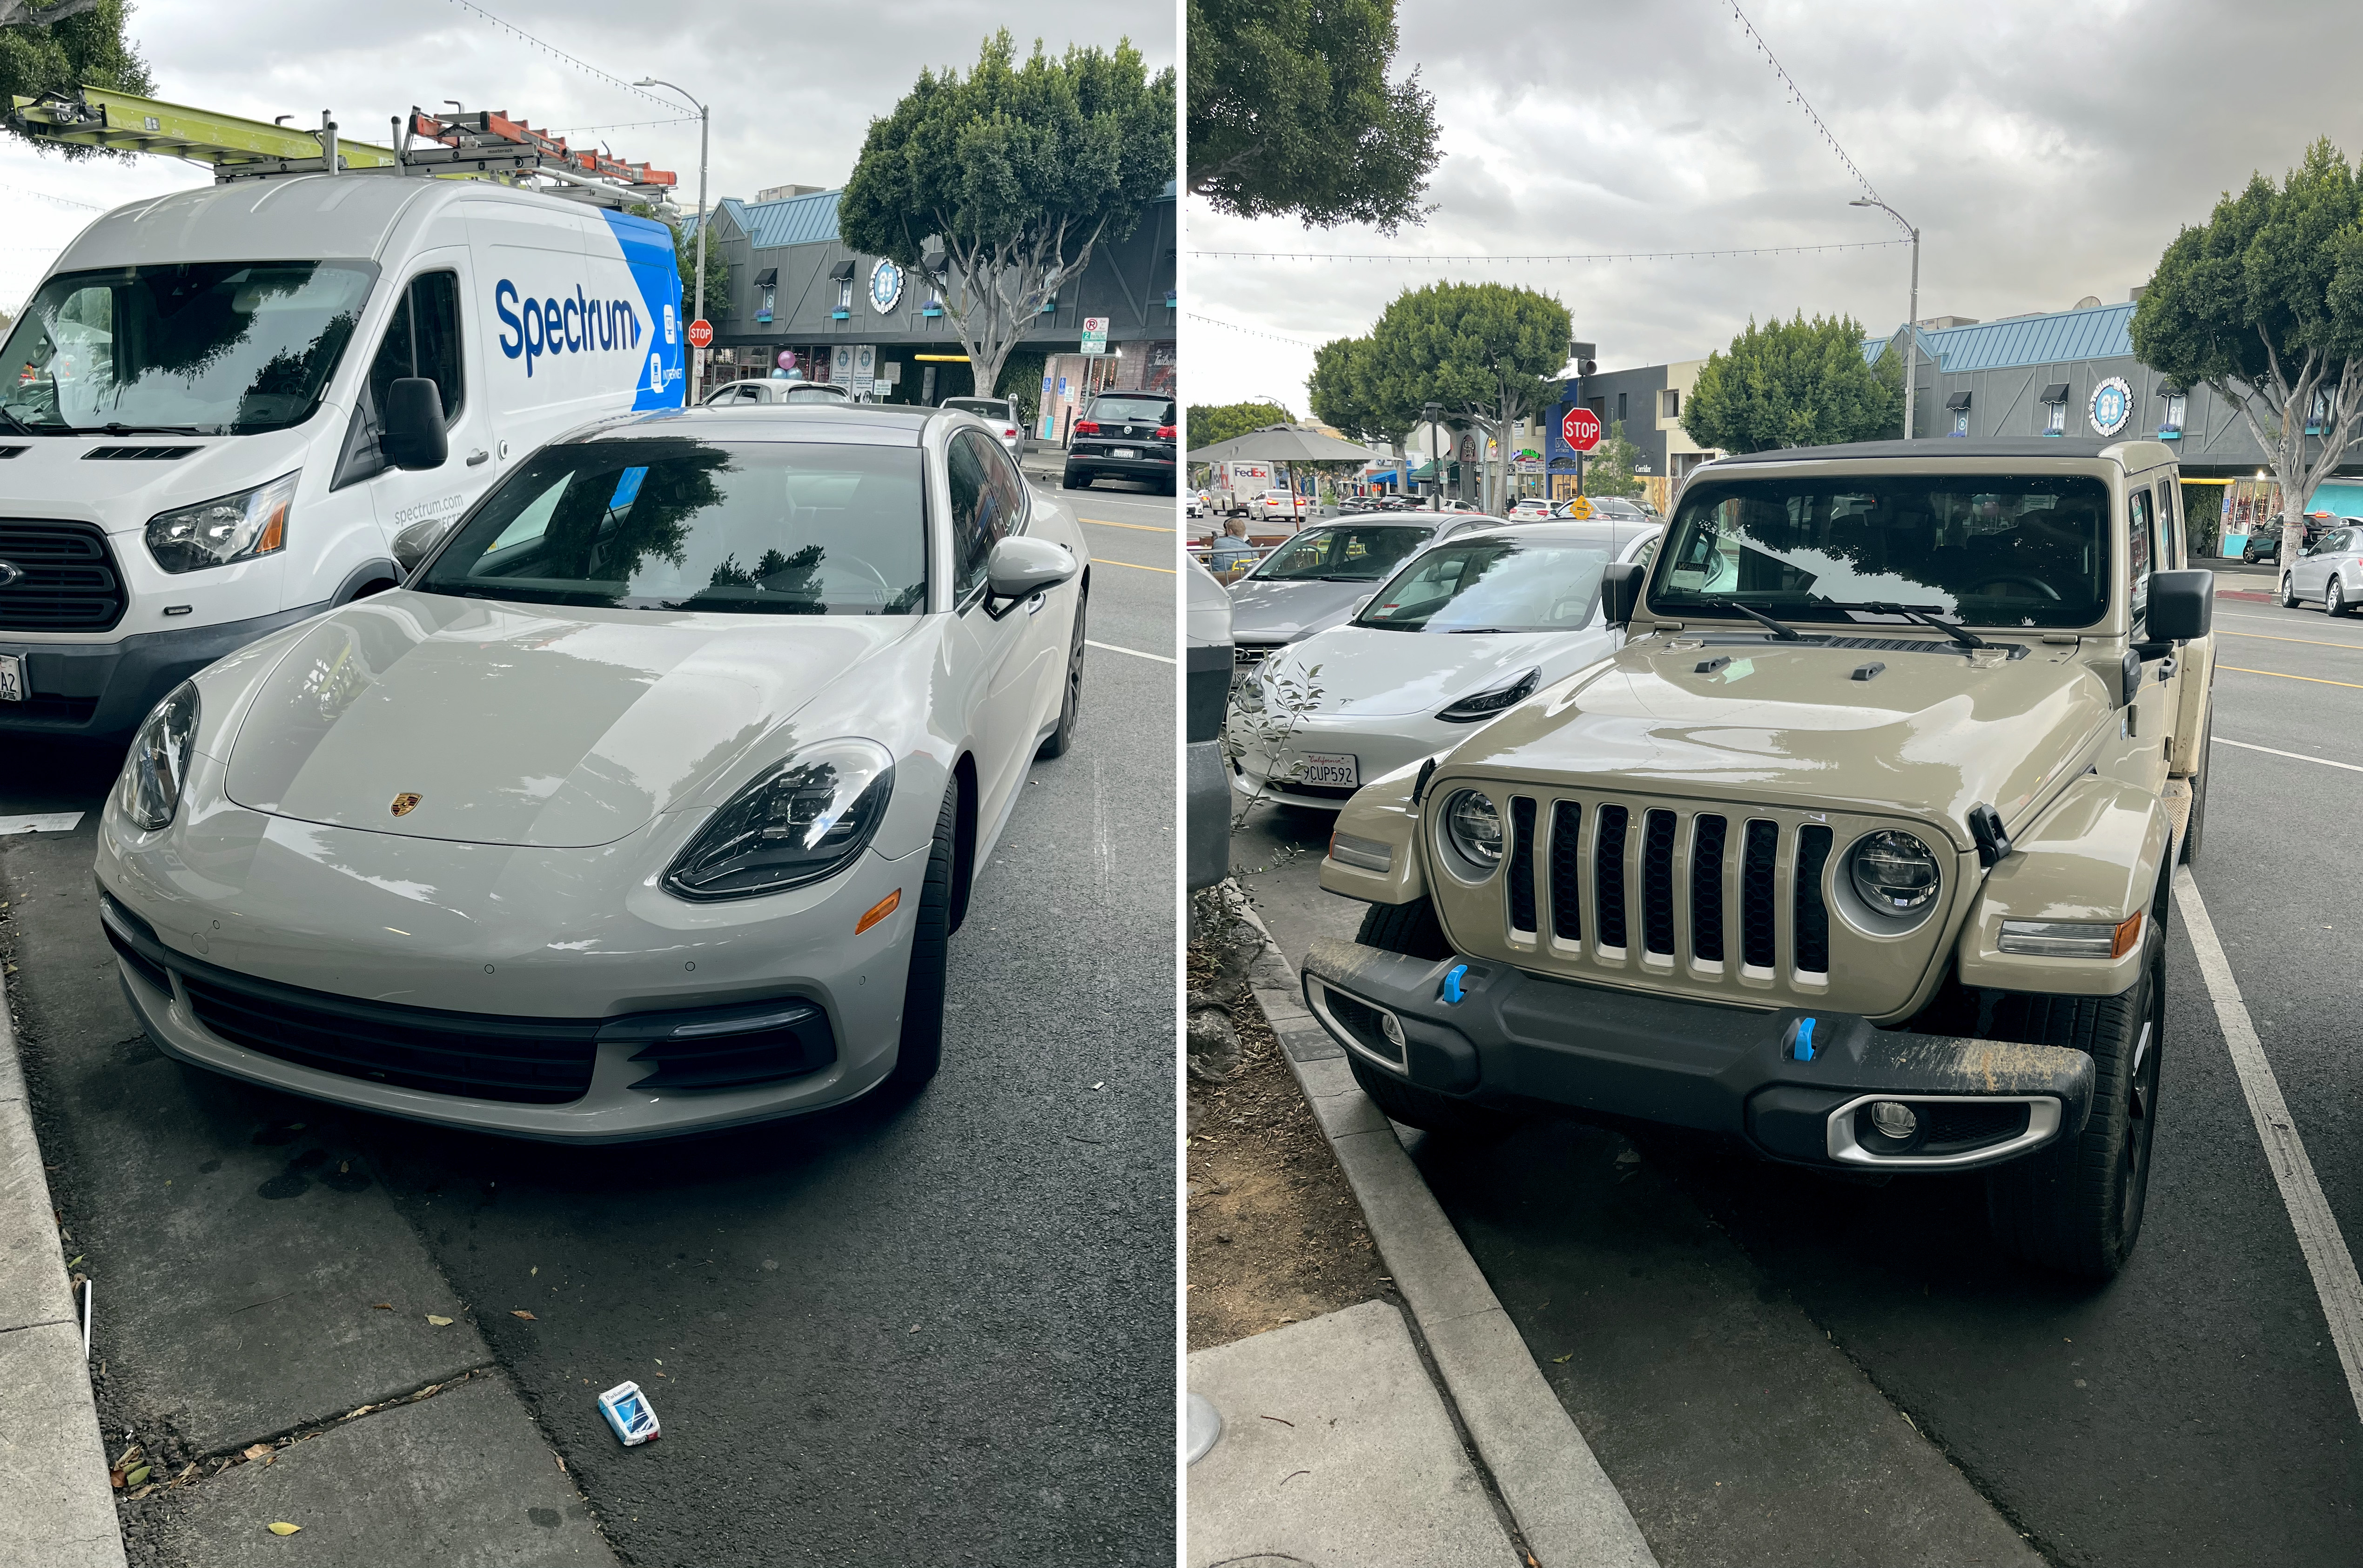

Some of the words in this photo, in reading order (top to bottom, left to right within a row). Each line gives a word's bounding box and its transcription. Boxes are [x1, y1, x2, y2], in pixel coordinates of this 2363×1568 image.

[495, 279, 636, 378] Spectrum
[691, 328, 711, 339] STOP
[663, 368, 683, 380] INTERNET
[1565, 421, 1598, 439] STOP
[1235, 467, 1267, 478] FedEx
[1635, 464, 1652, 473] Corridor
[395, 494, 463, 527] spectrum.com
[1310, 755, 1345, 765] California
[1303, 765, 1353, 783] 9CUP592
[605, 1384, 632, 1401] Parliament
